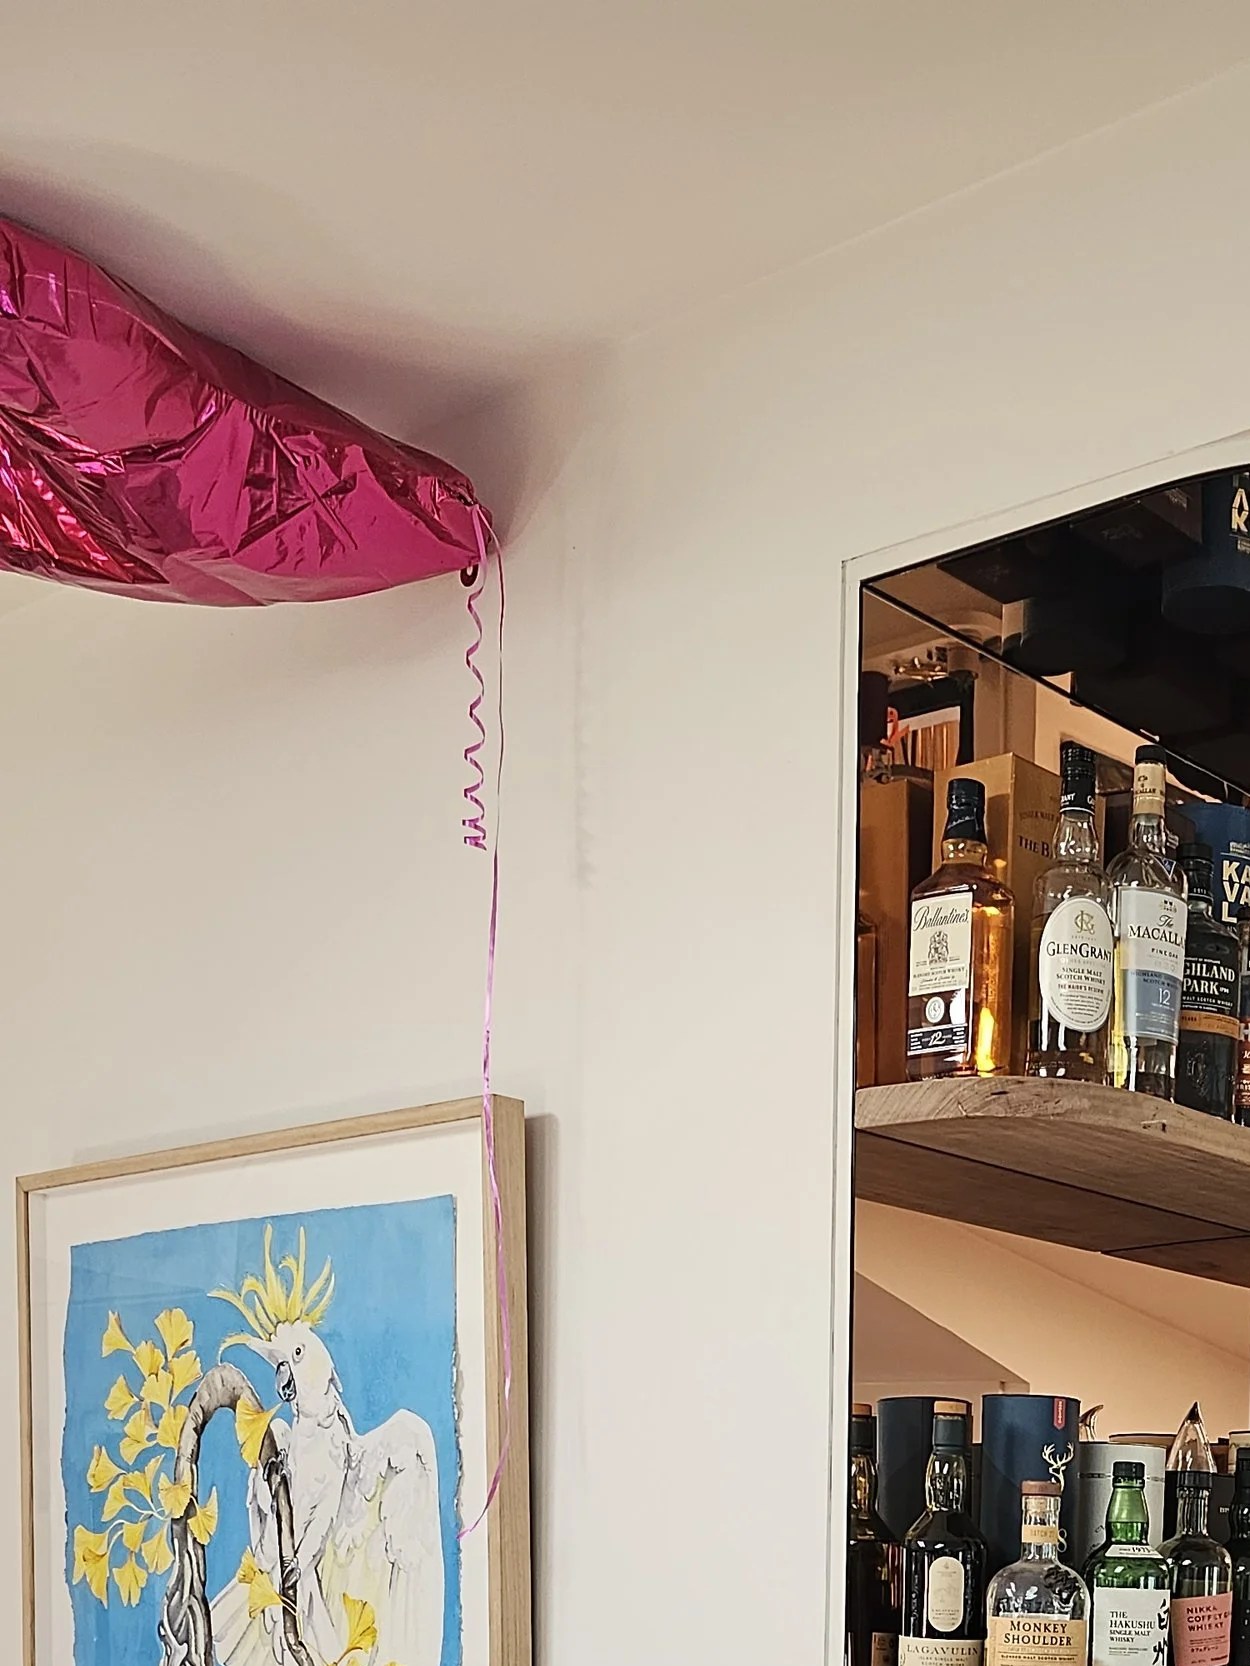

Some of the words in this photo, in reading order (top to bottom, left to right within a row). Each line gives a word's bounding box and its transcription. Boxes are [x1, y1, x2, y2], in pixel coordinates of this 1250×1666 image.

[1018, 835, 1038, 853] THE
[913, 906, 970, 932] Ballantine's
[1157, 915, 1175, 928] The
[1183, 978, 1220, 995] PARK
[1159, 988, 1171, 1006] 12
[1110, 1611, 1128, 1619] THE
[1010, 1620, 1068, 1634] MONKEY
[1109, 1620, 1156, 1629] HAKUSHU
[1003, 1633, 1072, 1646] SHOULDER
[906, 1644, 979, 1655] LAGAVULIN
